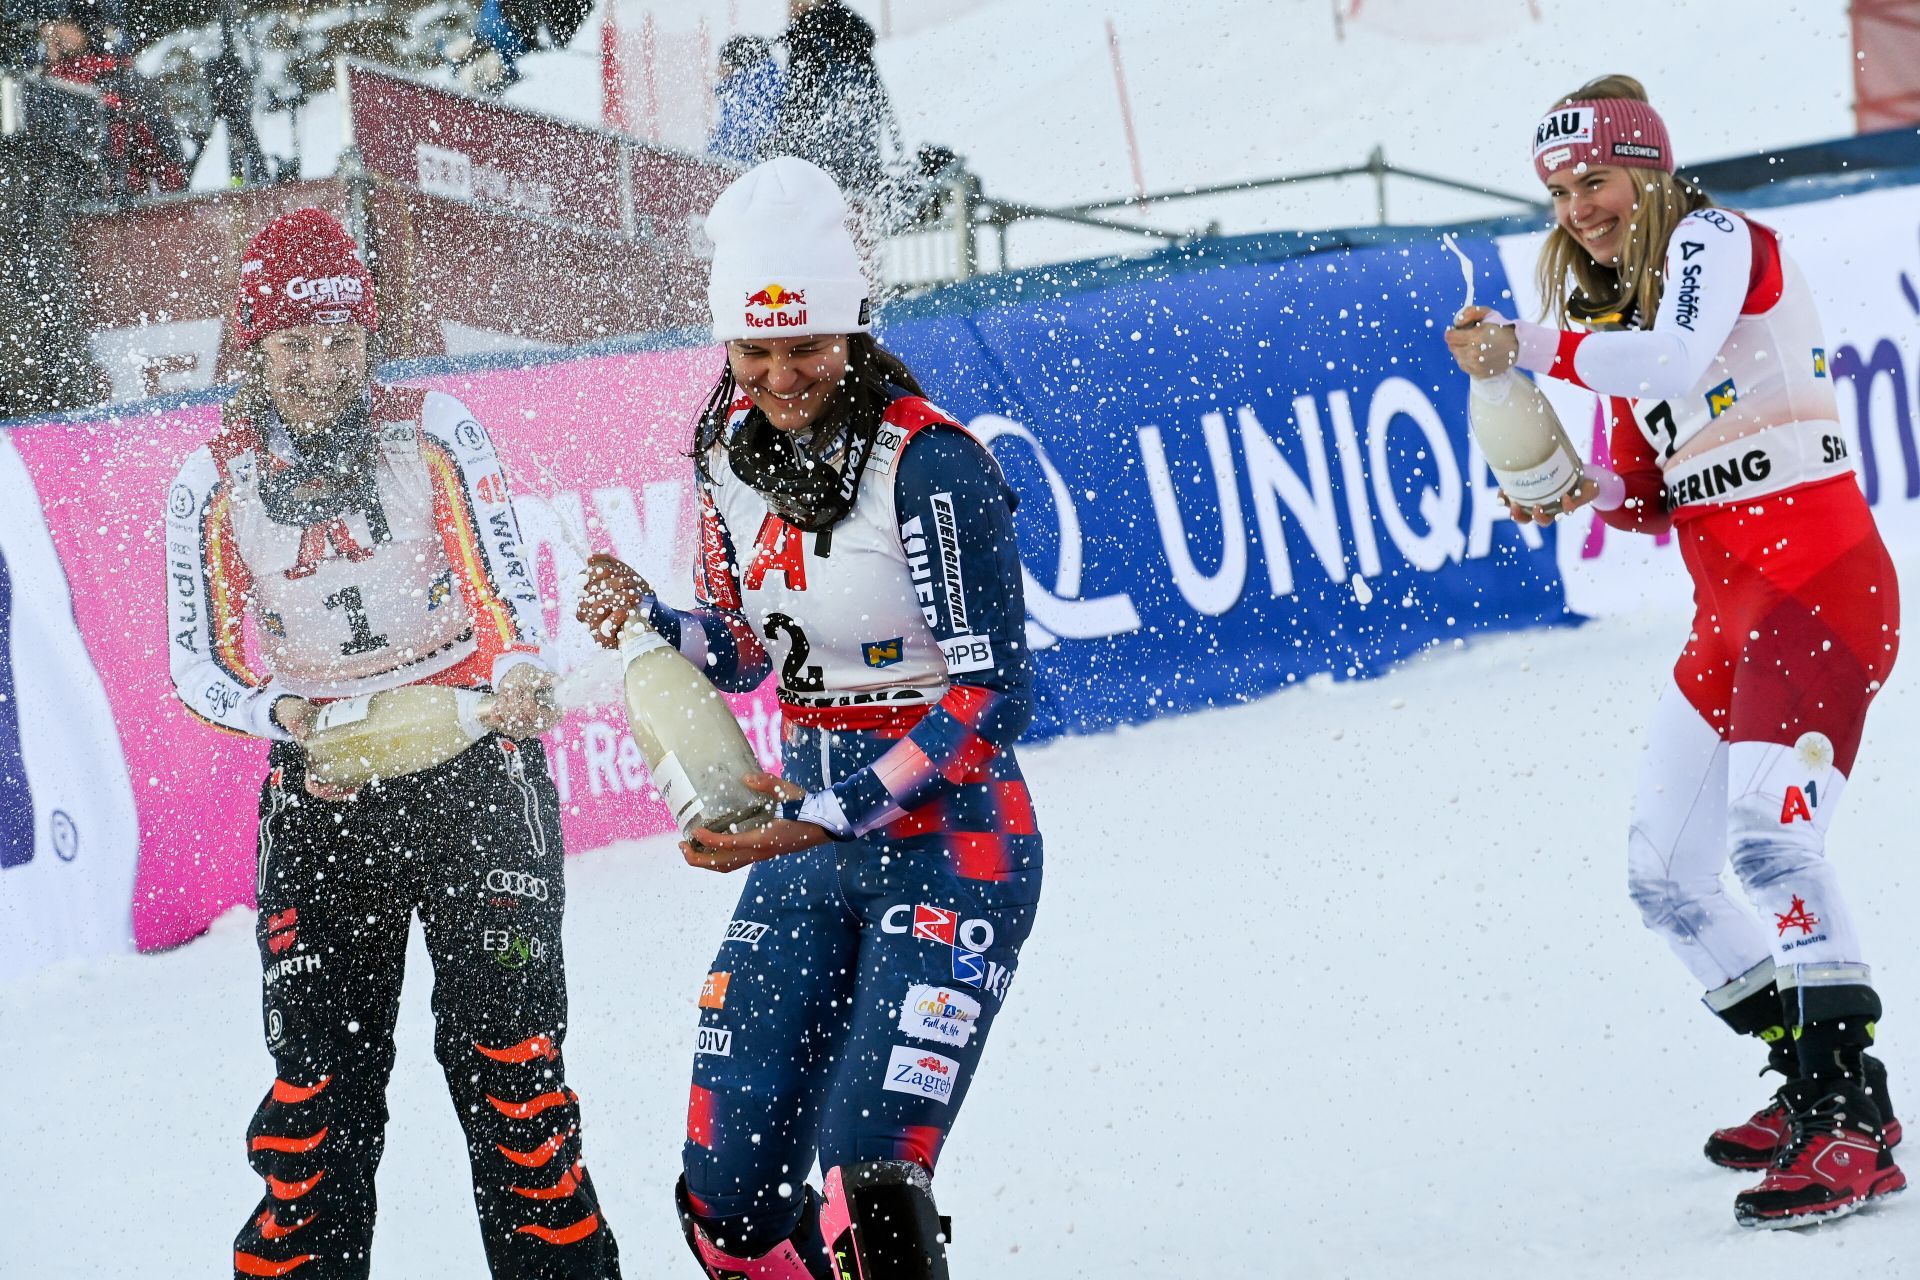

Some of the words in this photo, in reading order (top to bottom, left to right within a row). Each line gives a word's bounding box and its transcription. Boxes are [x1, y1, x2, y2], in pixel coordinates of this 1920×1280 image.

[1614, 144, 1659, 158] GIESSWEIN
[286, 275, 364, 301] Grapos
[745, 312, 775, 327] Red
[776, 310, 807, 327] Bull
[840, 432, 867, 501] uvex
[934, 498, 967, 629] ENERGIAPURA
[171, 560, 199, 655] Audi
[322, 585, 390, 656] 1
[763, 612, 825, 692] 2
[943, 641, 989, 666] HPB
[1780, 780, 1817, 824] A1
[1782, 943, 1794, 953] Ski
[1795, 934, 1827, 948] Austria
[263, 953, 321, 987] WÜRTH
[918, 1000, 968, 1023] CROATIA
[922, 1016, 938, 1029] Full
[893, 1064, 951, 1094] Zagreb
